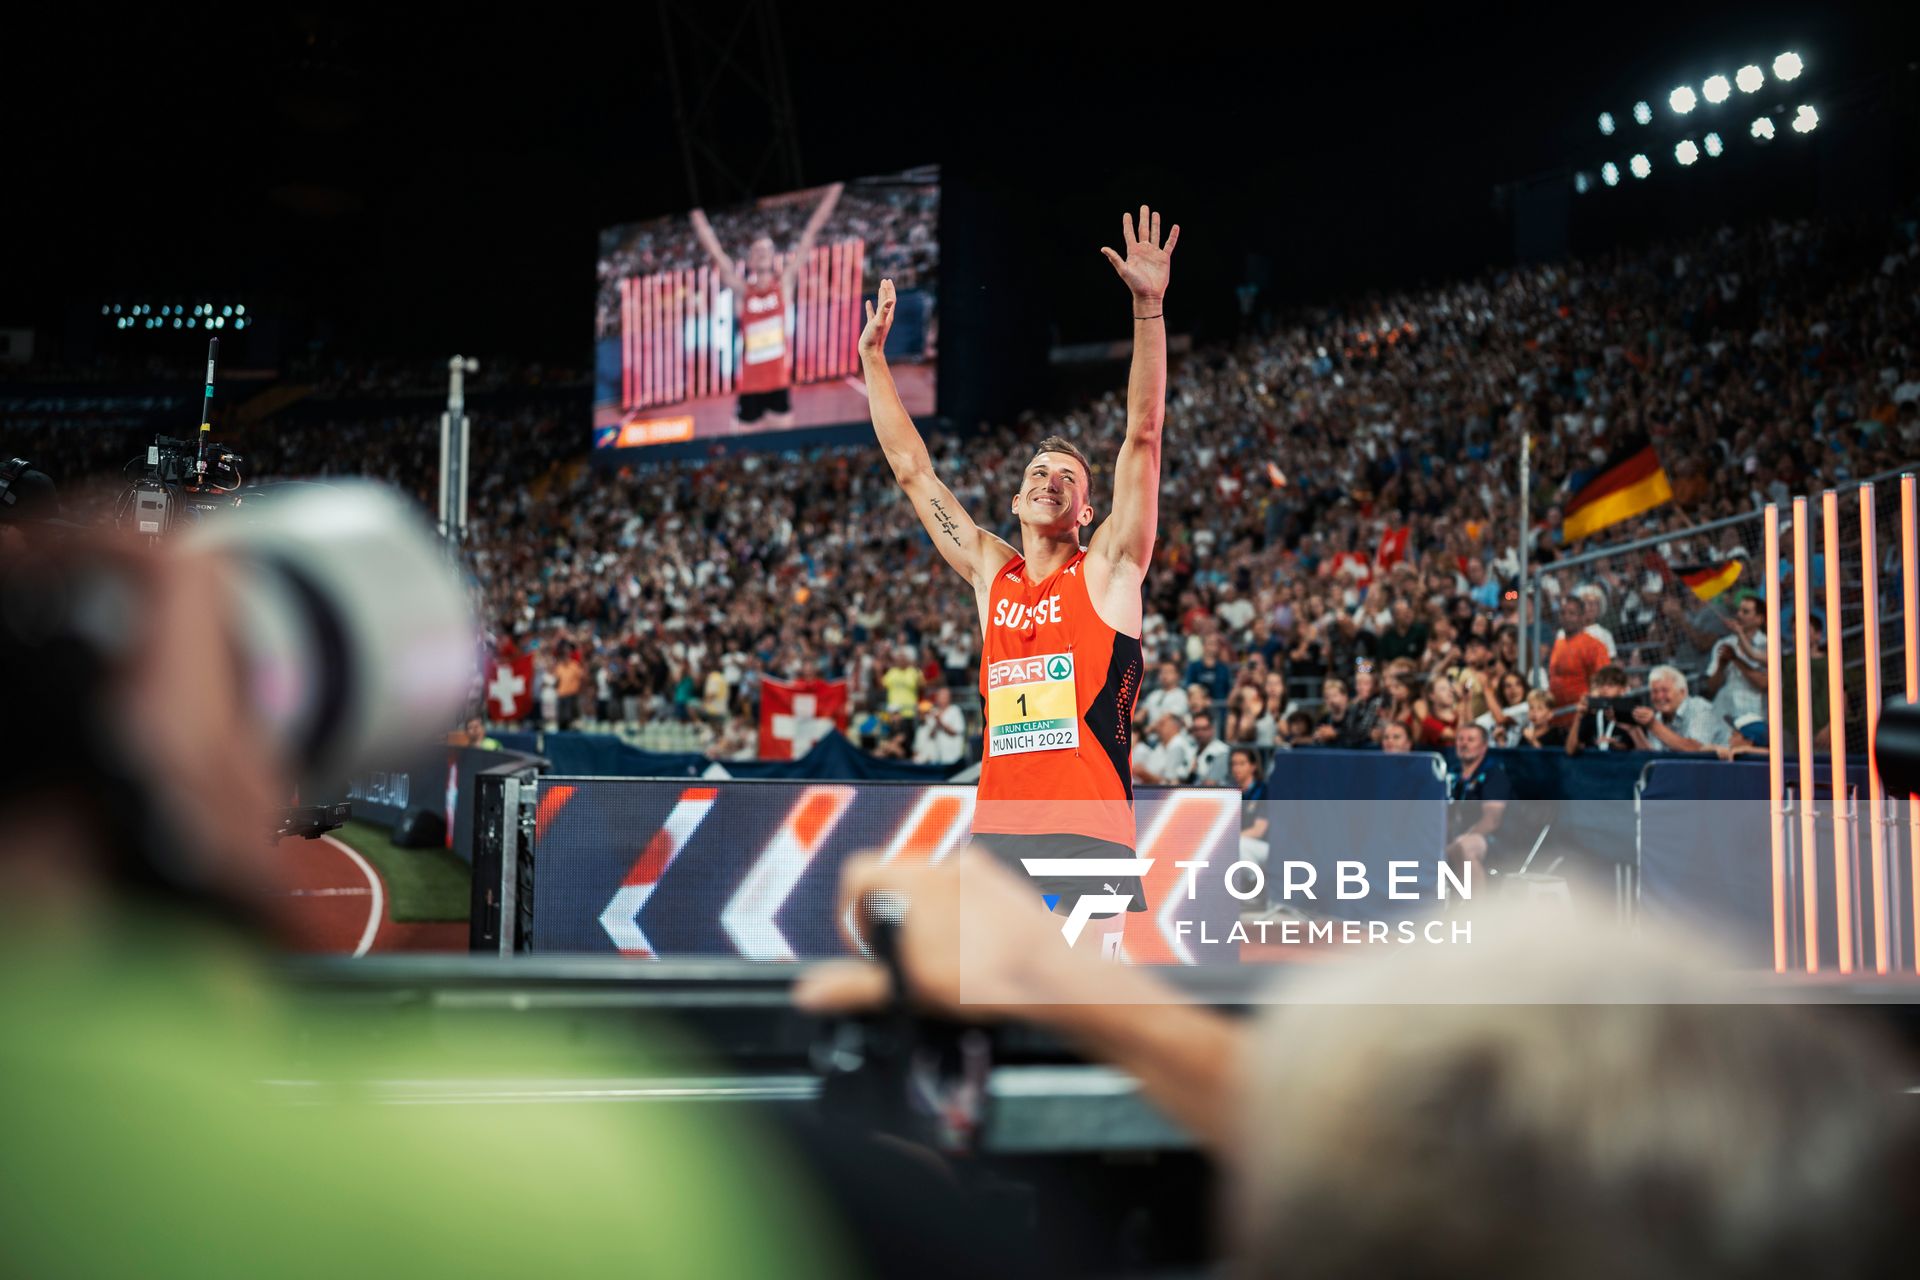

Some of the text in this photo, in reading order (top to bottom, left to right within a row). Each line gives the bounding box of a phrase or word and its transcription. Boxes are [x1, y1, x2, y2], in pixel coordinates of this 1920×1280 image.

[990, 661, 1044, 687] SPAR
[1016, 693, 1028, 717] 1
[1005, 724, 1021, 734] RUN
[993, 731, 1073, 752] MUNICH 2022
